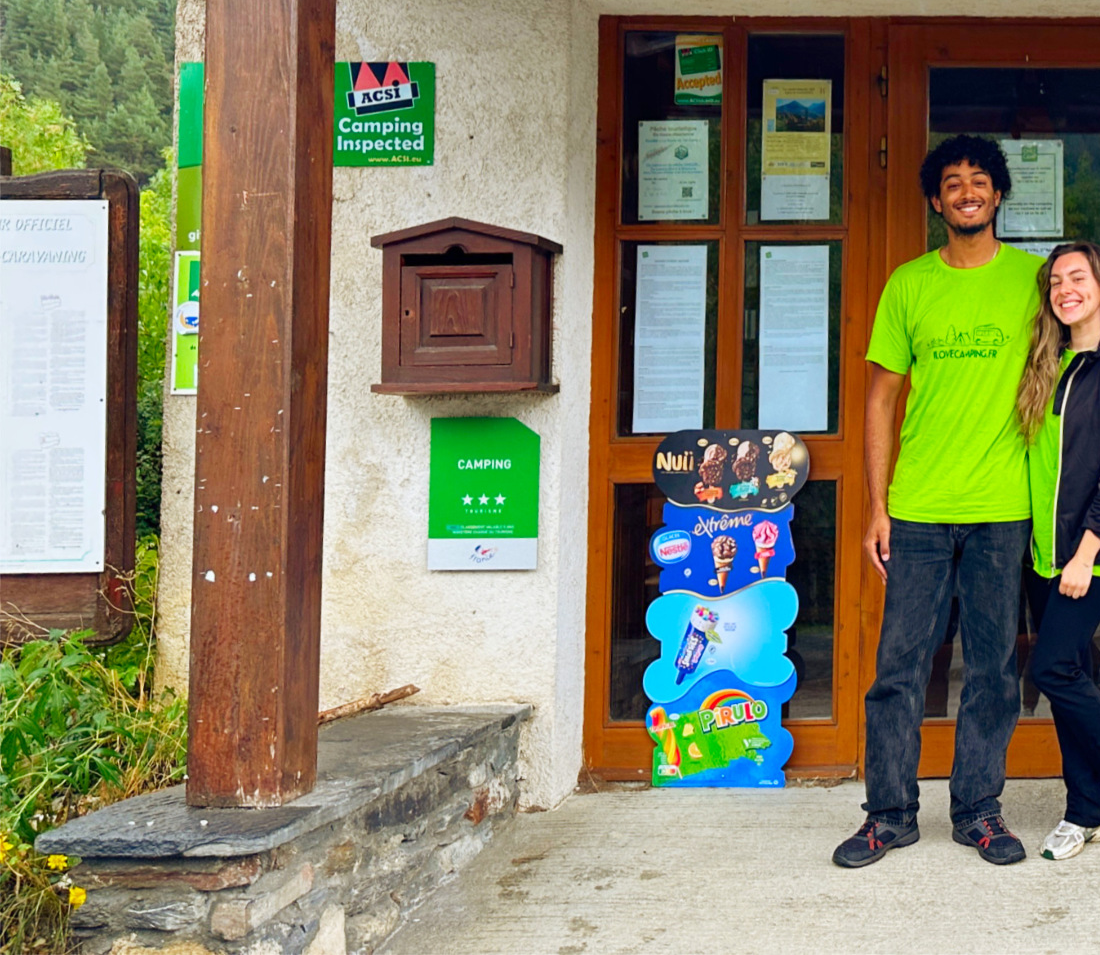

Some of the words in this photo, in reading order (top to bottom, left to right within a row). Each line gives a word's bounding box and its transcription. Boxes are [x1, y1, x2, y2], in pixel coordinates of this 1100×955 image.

[676, 72, 722, 91] Accepted
[338, 117, 424, 136] Camping
[337, 135, 425, 154] Inspected
[367, 155, 422, 163] www.ACSI.eu
[15, 217, 74, 232] OFFICIEL
[2, 249, 88, 264] CARAVANING
[457, 458, 512, 470] CAMPING
[656, 450, 695, 472] Nuii
[659, 542, 690, 557] Nestlé
